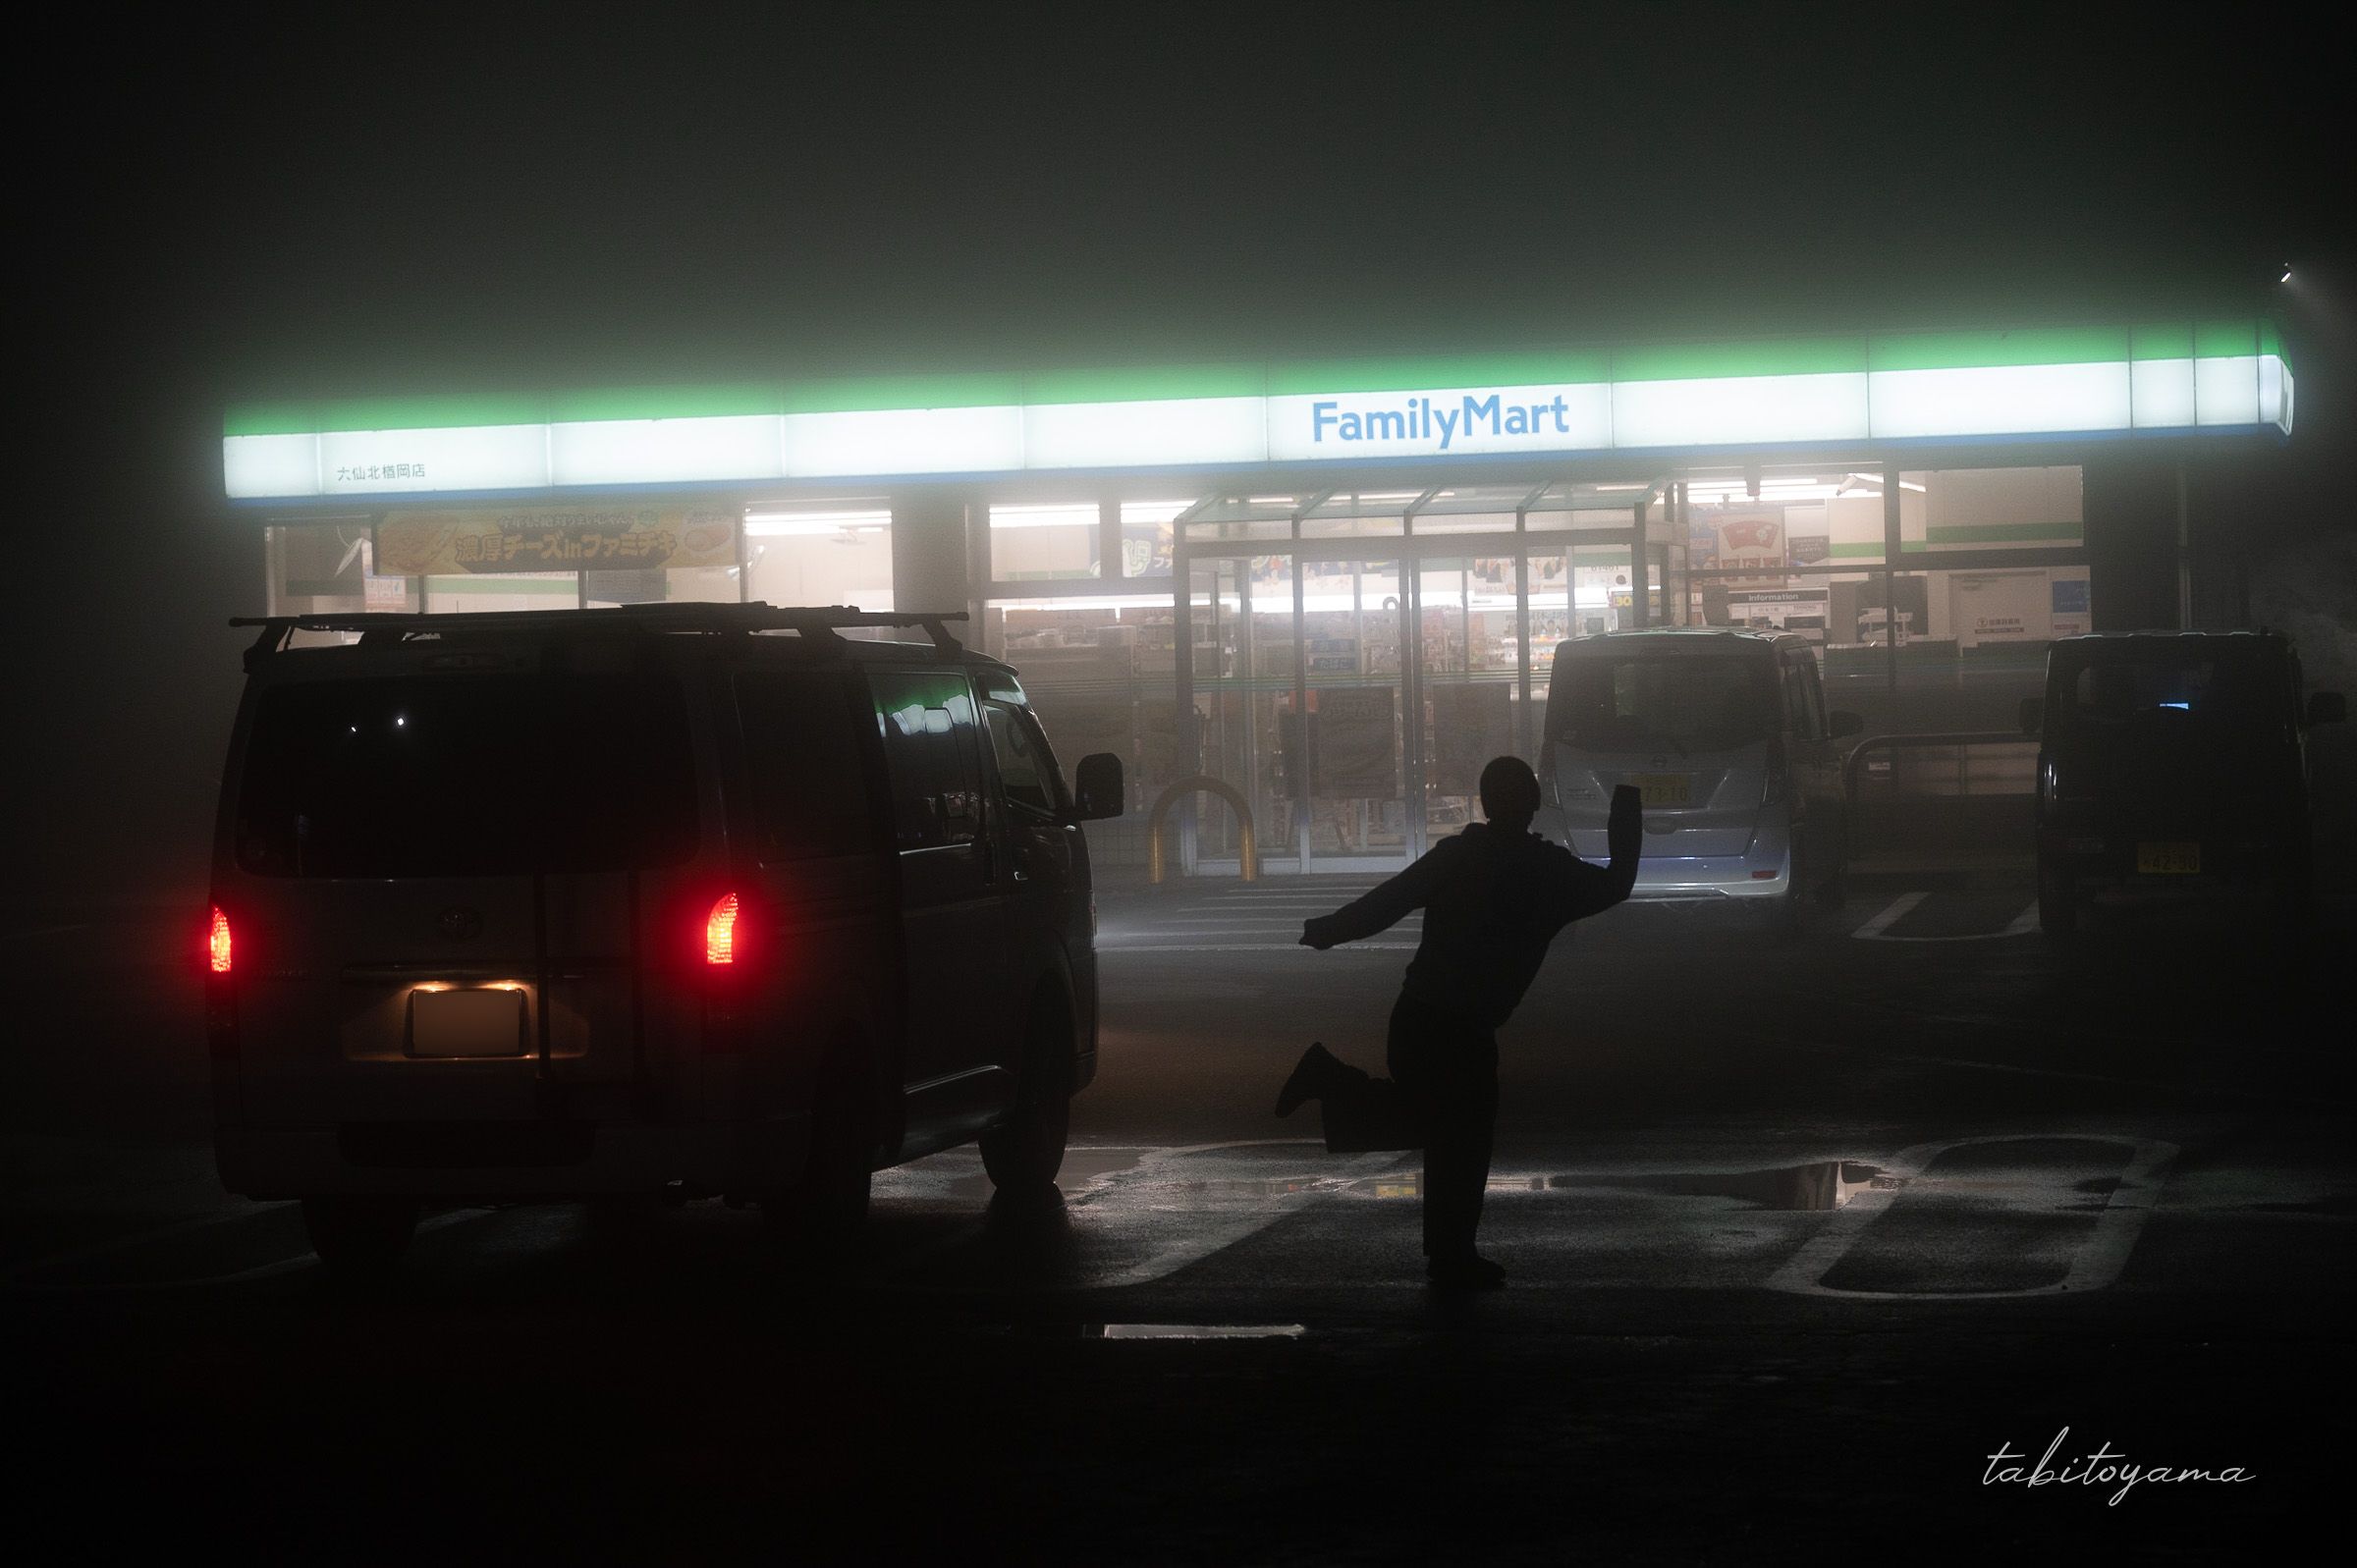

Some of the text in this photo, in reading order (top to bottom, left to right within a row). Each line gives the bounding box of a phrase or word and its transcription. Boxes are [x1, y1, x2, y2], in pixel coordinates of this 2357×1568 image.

[1312, 394, 1569, 449] FamilyMart
[336, 462, 425, 482] 大仙北楢岡店
[1748, 593, 1799, 602] Information
